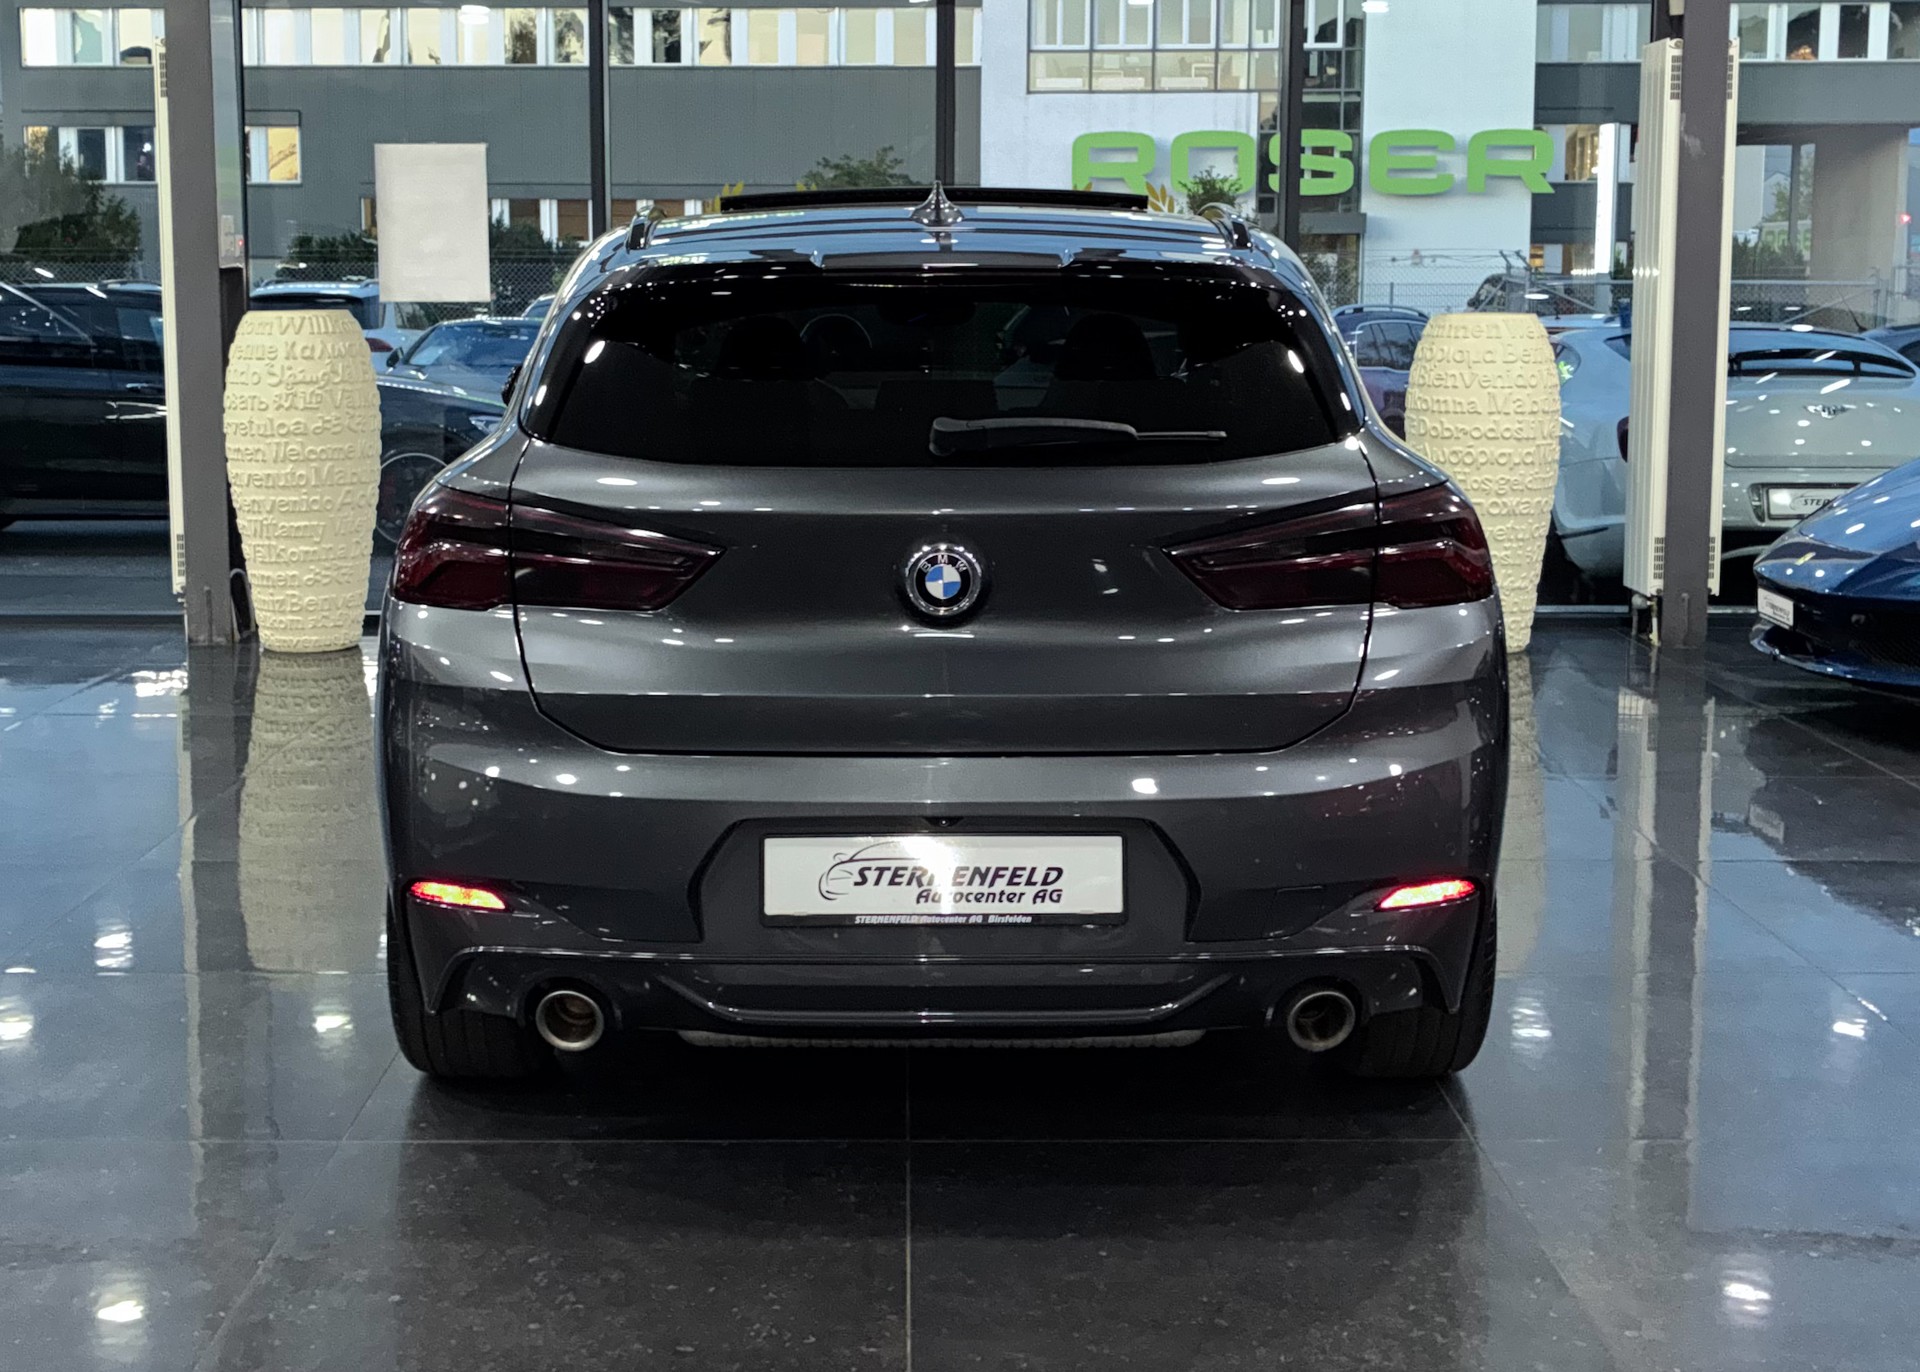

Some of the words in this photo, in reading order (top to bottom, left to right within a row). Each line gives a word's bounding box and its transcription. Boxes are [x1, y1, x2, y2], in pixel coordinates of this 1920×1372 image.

[1072, 129, 1555, 196] ROSER
[266, 440, 355, 464] Welcome
[920, 554, 968, 573] BMW
[916, 888, 1026, 904] Auocenter
[1032, 888, 1063, 905] AG
[855, 915, 918, 925] STERNENFELD
[968, 915, 983, 924] AG
[987, 915, 1033, 924] Birsfelden
